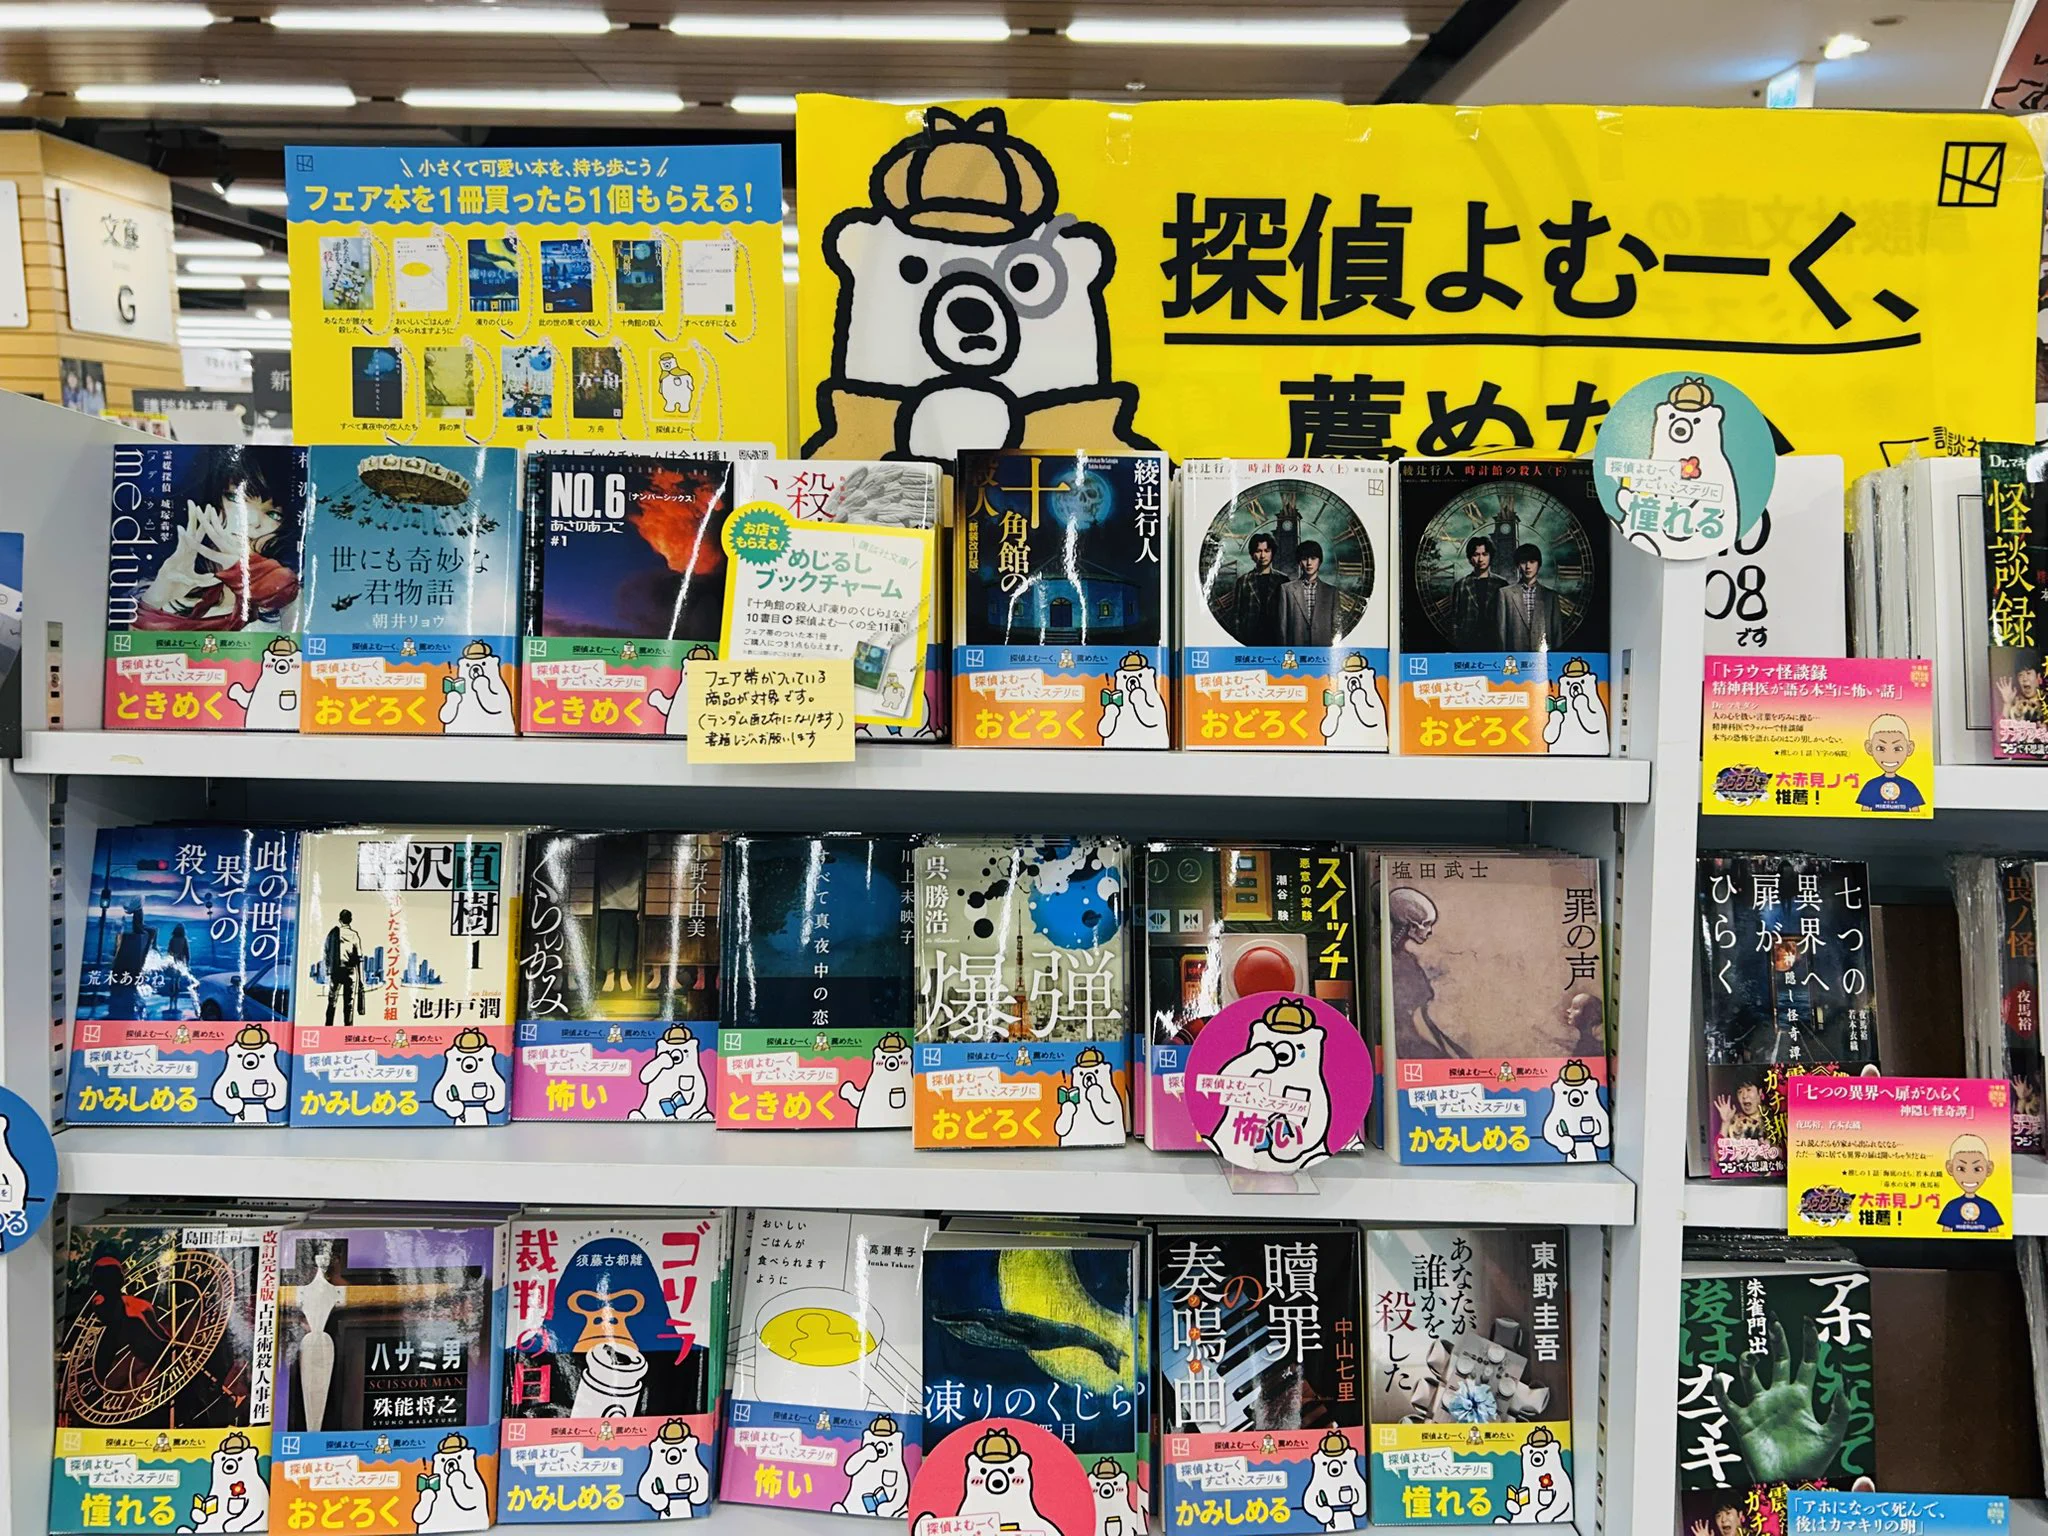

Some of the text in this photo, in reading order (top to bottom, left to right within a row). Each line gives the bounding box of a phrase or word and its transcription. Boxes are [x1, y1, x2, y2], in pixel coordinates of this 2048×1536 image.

[418, 158, 651, 178] 小さくて可愛い本を、持ち歩こう
[1160, 192, 1920, 330] 探偵よむーく、
[117, 284, 137, 325] G
[323, 317, 375, 327] あなたが誰かを
[338, 326, 360, 335] 殺した
[392, 326, 454, 336] 食べられますように
[395, 317, 453, 327] おいしいごはんが
[475, 317, 514, 327] 凍りのくじら
[538, 318, 603, 328] 此の世の果ての殺人
[620, 318, 664, 328] 十角館の殺人
[684, 318, 738, 328] すべてがFになる
[340, 421, 419, 432] すべて真夜中の恋人たち
[438, 422, 461, 432] 罪の声
[655, 424, 696, 434] 探偵よむーく
[161, 450, 173, 494] 霊媒探偵
[1403, 464, 1455, 477] 綾辻行人
[1610, 460, 1677, 477] 探偵よむーく
[550, 472, 626, 519] NO.6
[1632, 477, 1719, 499] すごいミステリに
[550, 519, 625, 534] あさのあつこ
[1134, 460, 1159, 565] 綾辻行人
[1627, 494, 1726, 538] 憧れる
[108, 449, 158, 627] medium
[550, 534, 568, 547] #1
[736, 536, 786, 551] もらえる!
[743, 522, 780, 537] お店で
[329, 545, 491, 574] 世にも奇妙な
[788, 549, 873, 574] めじるし
[1987, 478, 2037, 649] 怪談録
[364, 577, 455, 607] 君物語
[756, 568, 904, 600] ブックチャーム
[372, 612, 446, 630] 朝井リョウ
[744, 628, 828, 641] フェア帯のついた本1冊
[1736, 626, 1768, 648] です
[121, 656, 182, 671] 探偵よむーく
[144, 667, 222, 682] すごいミステリに
[705, 667, 826, 688] フェア帯がついている
[1712, 662, 1828, 682] 「トラウマ怪談録
[116, 690, 223, 721] ときめく
[705, 688, 815, 706] 商品が対象です。
[1712, 681, 1904, 702] 精神科医が語る本当に怖い話」
[314, 694, 427, 726] おどろく
[532, 695, 645, 728] ときめく
[975, 707, 1086, 740] おどろく
[1199, 708, 1310, 740] おどろく
[705, 731, 817, 748] 書籍レジへお願いします
[1418, 714, 1532, 748] おどろく
[1776, 772, 1860, 789] 大赤見ノヴ
[1775, 789, 1821, 807] 推薦!
[172, 844, 207, 906] 殺人
[1391, 861, 1489, 880] 塩田武士
[210, 854, 243, 944] 果ての
[250, 840, 287, 961] 此の世の
[688, 845, 709, 939] 小野不由美
[900, 850, 915, 946] 川上未映子
[924, 856, 950, 935] 呉勝浩
[1299, 857, 1313, 922] 悪意の実験
[1316, 857, 1349, 979] スイッチ
[1751, 873, 1783, 953] 扉が
[1561, 887, 1600, 991] 罪の声
[1709, 875, 1738, 995] ひらく
[1794, 874, 1830, 992] 異界へ
[1834, 876, 1866, 997] 七つの
[87, 970, 166, 988] 荒木あかね
[914, 948, 1122, 1041] 爆弾
[1783, 951, 1802, 1060] 神隠し怪奇譚
[412, 998, 502, 1020] 池井戸潤
[2017, 989, 2033, 1032] 夜馬裕
[192, 1029, 225, 1039] 薦めたい
[88, 1047, 152, 1062] 探偵よむーく
[112, 1060, 193, 1075] すごいミステリを
[526, 1046, 586, 1061] 探偵よむーく
[548, 1058, 627, 1073] すごいミステリが
[545, 1079, 609, 1112] 怖い
[1200, 1076, 1265, 1093] 探偵よむーく
[1796, 1083, 1962, 1102] 「七つの異界へ扉がひらく
[78, 1085, 199, 1113] かみしめる
[300, 1089, 420, 1118] かみしめる
[726, 1090, 836, 1122] ときめく
[1223, 1093, 1307, 1113] すごいミステリが
[1900, 1104, 1976, 1120] 神隠し怪奇譚」
[931, 1108, 1043, 1140] おどろく
[1233, 1111, 1304, 1146] 怖い
[1408, 1125, 1532, 1153] かみしめる
[1859, 1192, 1941, 1210] 大赤見ノヴ
[762, 1219, 808, 1231] おいしい
[1859, 1209, 1903, 1226] 推薦!
[185, 1230, 243, 1248] 島田荘司
[760, 1238, 806, 1250] ごはんが
[868, 1243, 918, 1258] 高瀬隼子
[259, 1230, 279, 1302] 改訂完全版
[576, 1253, 643, 1267] 須藤古都離
[757, 1256, 827, 1270] 食べられます
[656, 1220, 711, 1367] ゴリラ
[755, 1273, 789, 1286] ように
[1223, 1274, 1264, 1312] の
[1450, 1236, 1478, 1336] あなたが
[1262, 1241, 1324, 1363] 贖罪
[1411, 1253, 1450, 1340] 誰かを
[1531, 1241, 1561, 1362] 東野圭吾
[512, 1227, 559, 1406] 裁判の日
[1746, 1277, 1769, 1356] 朱雀門出
[1163, 1241, 1229, 1428] 奏鳴曲
[1373, 1289, 1419, 1394] 殺した
[252, 1303, 275, 1424] 占星術殺人事件
[370, 1338, 462, 1372] ハサミ男
[1334, 1317, 1356, 1403] 中山七里
[369, 1376, 464, 1391] SCISSOR MAN
[372, 1395, 458, 1418] 殊能将之
[923, 1379, 1133, 1424] 凍りのくじら
[173, 1437, 206, 1447] 薦めたい
[514, 1446, 578, 1461] 探偵よむーく
[539, 1458, 619, 1473] すごいミステリを
[754, 1463, 814, 1499] 怖い
[80, 1493, 177, 1527] 憧れる
[506, 1483, 626, 1513] かみしめる
[1175, 1496, 1291, 1527] かみしめる
[1402, 1485, 1493, 1518] 憧れる
[286, 1496, 400, 1530] おどろく
[926, 1516, 995, 1536] 探偵よむーく
[1796, 1515, 1926, 1536] 後はカマキリの卵」
